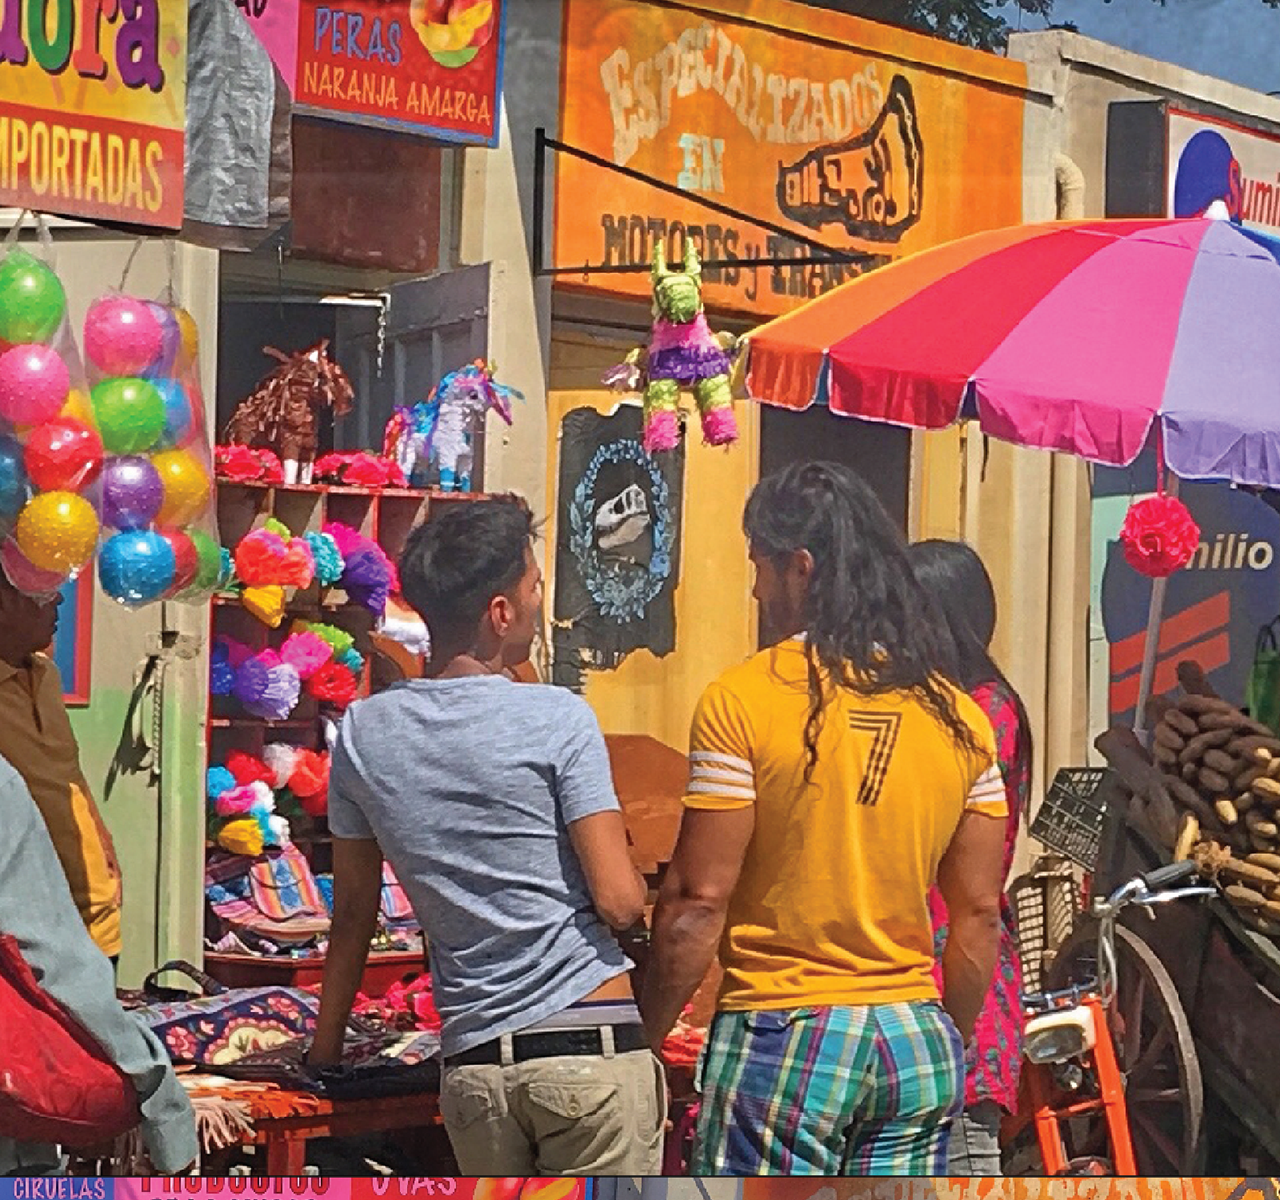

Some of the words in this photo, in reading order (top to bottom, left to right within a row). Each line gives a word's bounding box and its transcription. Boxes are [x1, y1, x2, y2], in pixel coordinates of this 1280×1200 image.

[314, 7, 403, 67] PERAS
[303, 61, 399, 111] NARANJA
[406, 82, 491, 126] AMARGA
[600, 22, 887, 166] ESPECIALIZADOS
[677, 133, 726, 193] EN
[847, 709, 902, 806] 7
[13, 1177, 106, 1200] CIRUELAS
